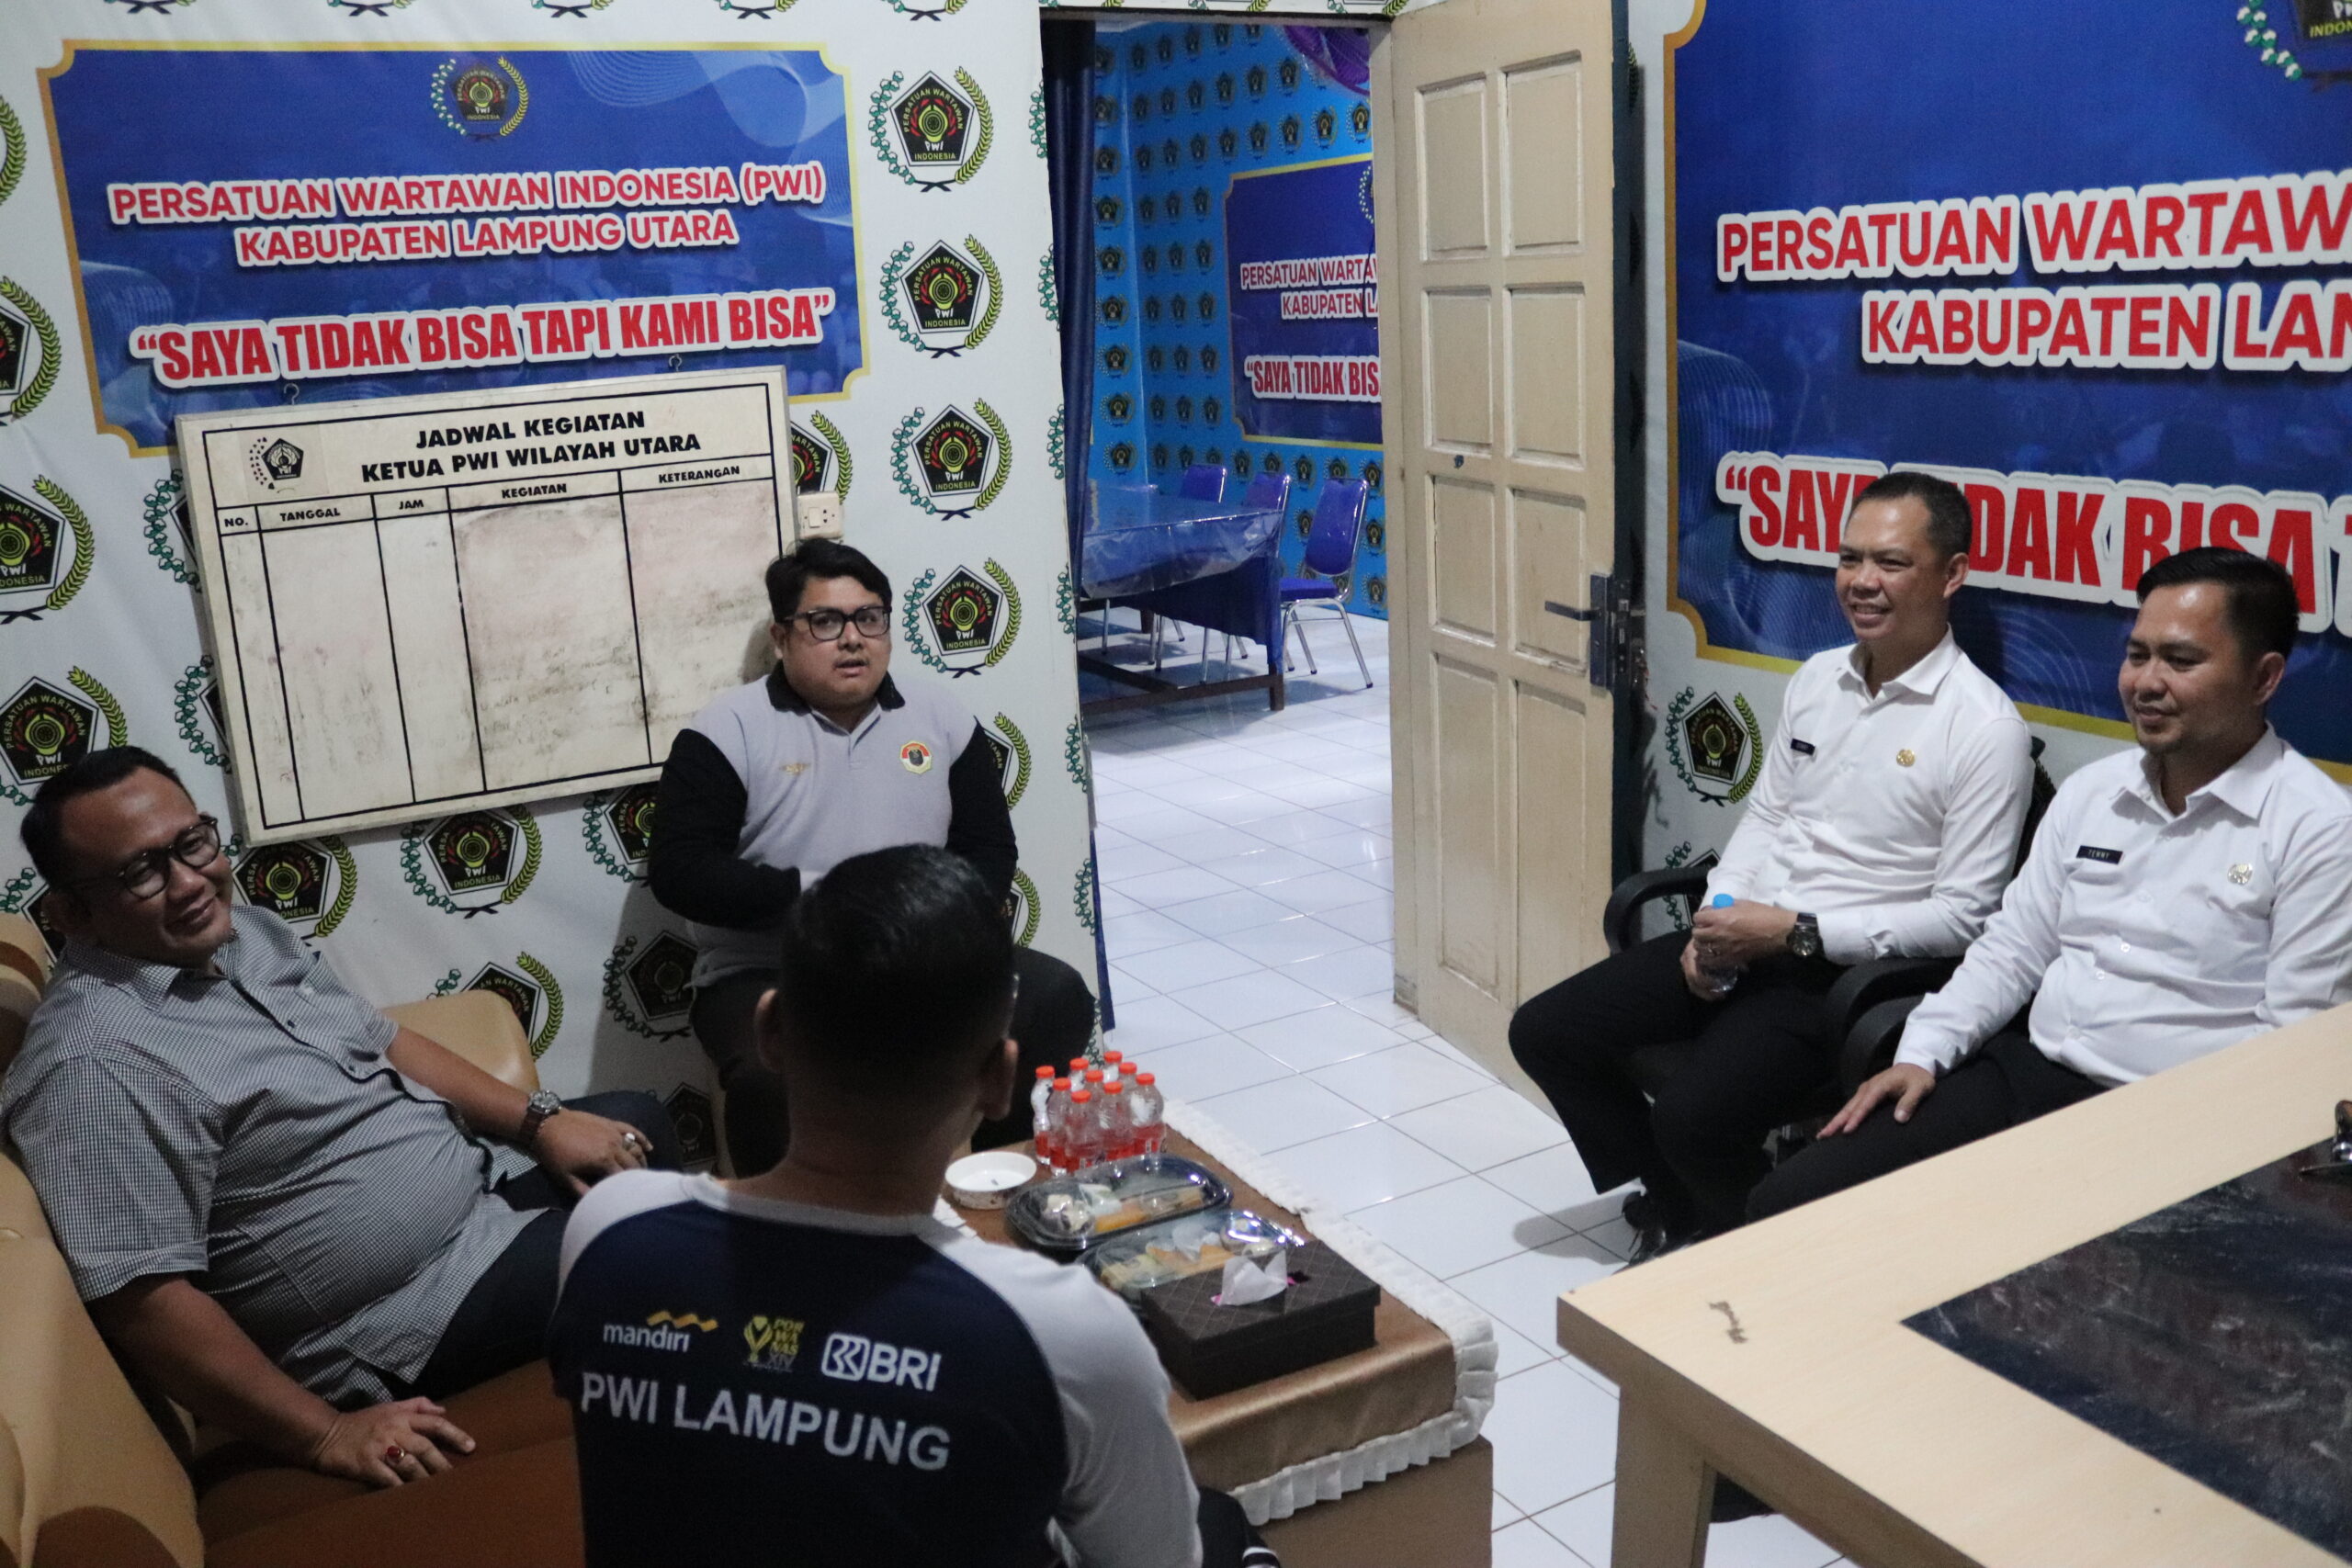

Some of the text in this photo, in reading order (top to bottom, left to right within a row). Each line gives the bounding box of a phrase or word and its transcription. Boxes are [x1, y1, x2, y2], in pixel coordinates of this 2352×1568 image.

[903, 87, 963, 132] PERSATUAN WARTAWAN
[914, 152, 956, 161] INDONESIA
[924, 141, 944, 152] PWI
[114, 165, 823, 220] PERSATUAN WARTAWAN INDONESIA (PWI)
[240, 213, 735, 262] KABUPATEN LAMPUNG UTARA
[1724, 183, 2352, 273] PERSATUAN WARTAW
[913, 255, 973, 301] PERSATUAN WARTAWAN
[1242, 262, 1317, 287] PERSATUAN
[934, 308, 954, 319] PWI
[1283, 292, 1363, 316] KABUPATEN
[137, 294, 831, 380] “SAYA TIDAK BISA TAPI KAMI BISA”
[924, 318, 967, 328] INDONESIA
[1869, 295, 2211, 357] KABUPATEN
[1294, 361, 1345, 395] TIDAK
[1348, 361, 1382, 397] BIS
[415, 411, 645, 449] JADWAL KEGIATAN
[924, 420, 982, 466] PERSATUAN WARTAWAN
[361, 433, 701, 483] KETUA PWI WILAYAH UTARA
[945, 470, 965, 481] PWI
[224, 465, 741, 527] NO. TANGGAL JAM KEGIATAN KETERANGAN
[935, 480, 977, 491] INDONESIA
[934, 580, 992, 626] PERSATUAN WARTAWAN
[946, 638, 986, 649] INDONESIA
[956, 629, 974, 640] PWI
[4, 694, 86, 750] PERSATUAN WARTAWAN
[36, 751, 62, 766] PWI
[454, 874, 501, 889] INDONESIA
[464, 864, 486, 877] PWI
[276, 897, 298, 909] PWI
[603, 1323, 690, 1353] mandiri
[867, 1343, 942, 1392] BRI
[581, 1371, 951, 1472] PWI LAMPUNG
